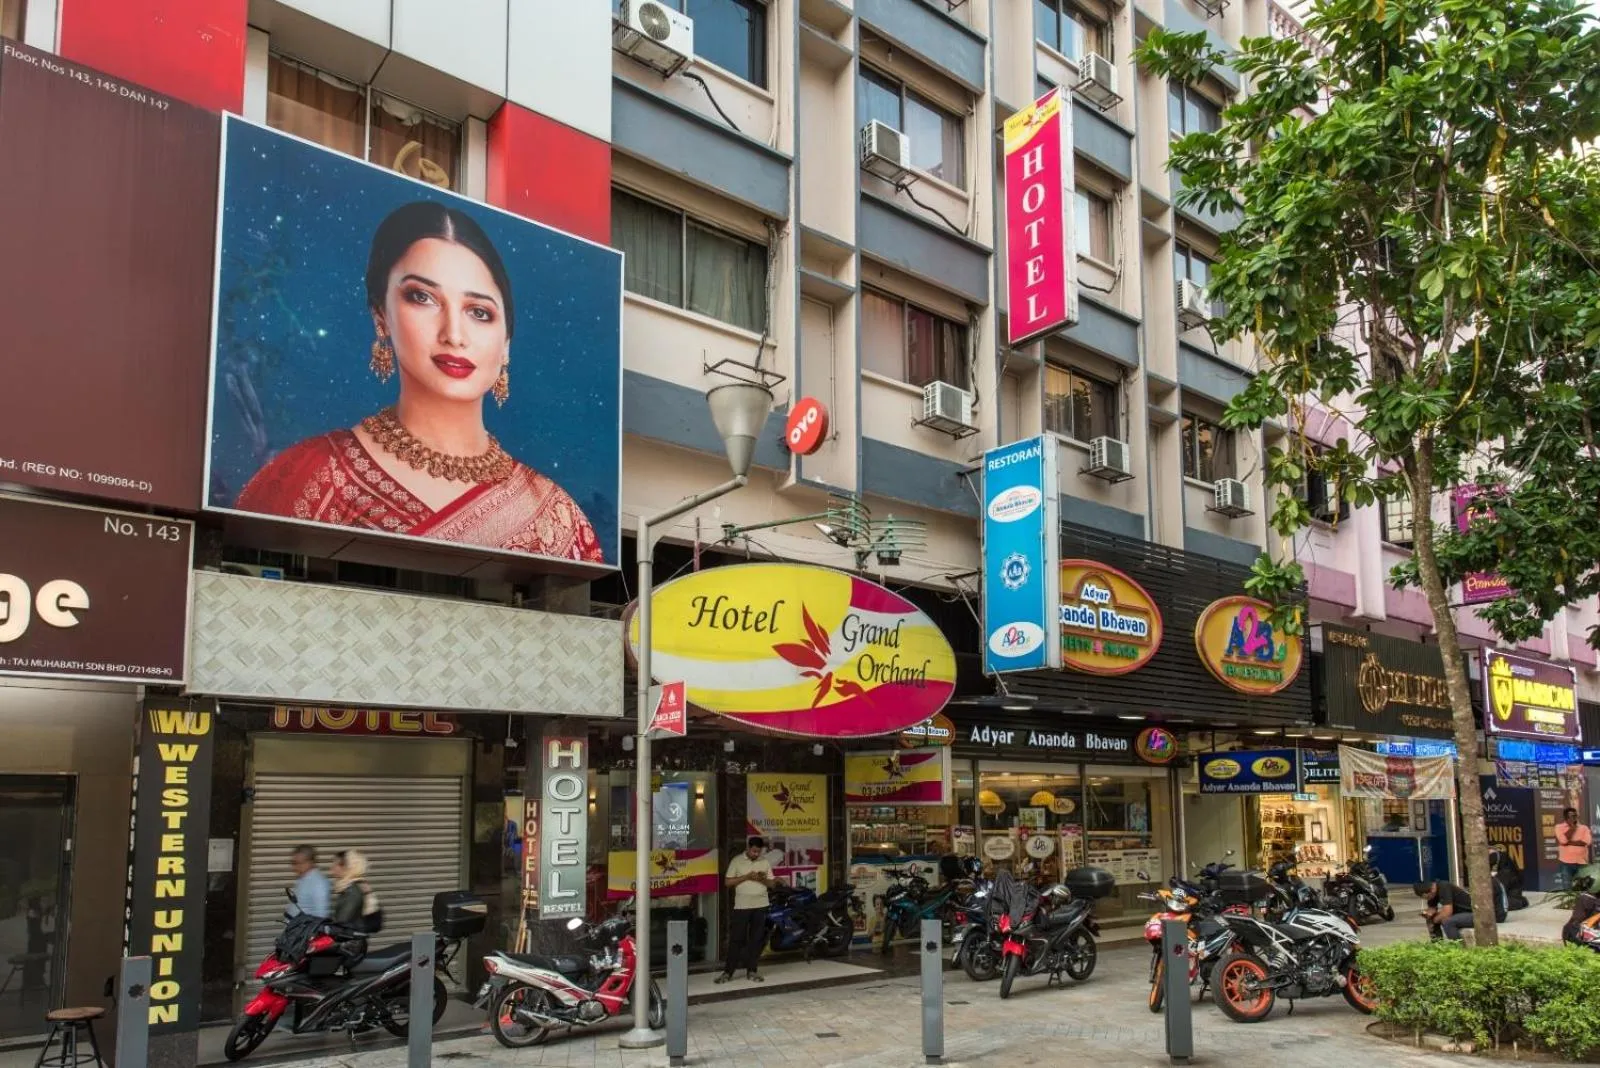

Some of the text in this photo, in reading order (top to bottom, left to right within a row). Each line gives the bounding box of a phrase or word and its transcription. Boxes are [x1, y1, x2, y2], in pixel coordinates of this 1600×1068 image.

[4, 45, 170, 112] Floor, Nos 143, 145 DAN 147
[1021, 143, 1048, 325] HOTEL
[790, 406, 818, 444] OYO
[988, 445, 1041, 472] RESTORAN
[22, 461, 56, 476] (REG
[59, 468, 83, 480] NO:
[87, 472, 153, 493] 1099084-D)
[104, 516, 180, 541] No. 143
[1083, 585, 1110, 602] Adyar
[688, 595, 785, 634] Hotel
[1058, 604, 1146, 634] anda Bhavan
[841, 613, 904, 653] Grand
[13, 657, 173, 676] TAJ MUHABATH SDN BHD (721488-K)
[857, 653, 931, 689] Orchard
[970, 725, 1128, 750] Adyar Ananda Bhavan
[1227, 783, 1260, 791] Ananda
[1262, 782, 1295, 790] Bhavan
[548, 740, 584, 899] HOTEL
[1487, 826, 1522, 842] NING
[148, 743, 199, 1025] WESTERN UNION
[543, 902, 582, 914] BESTEL
